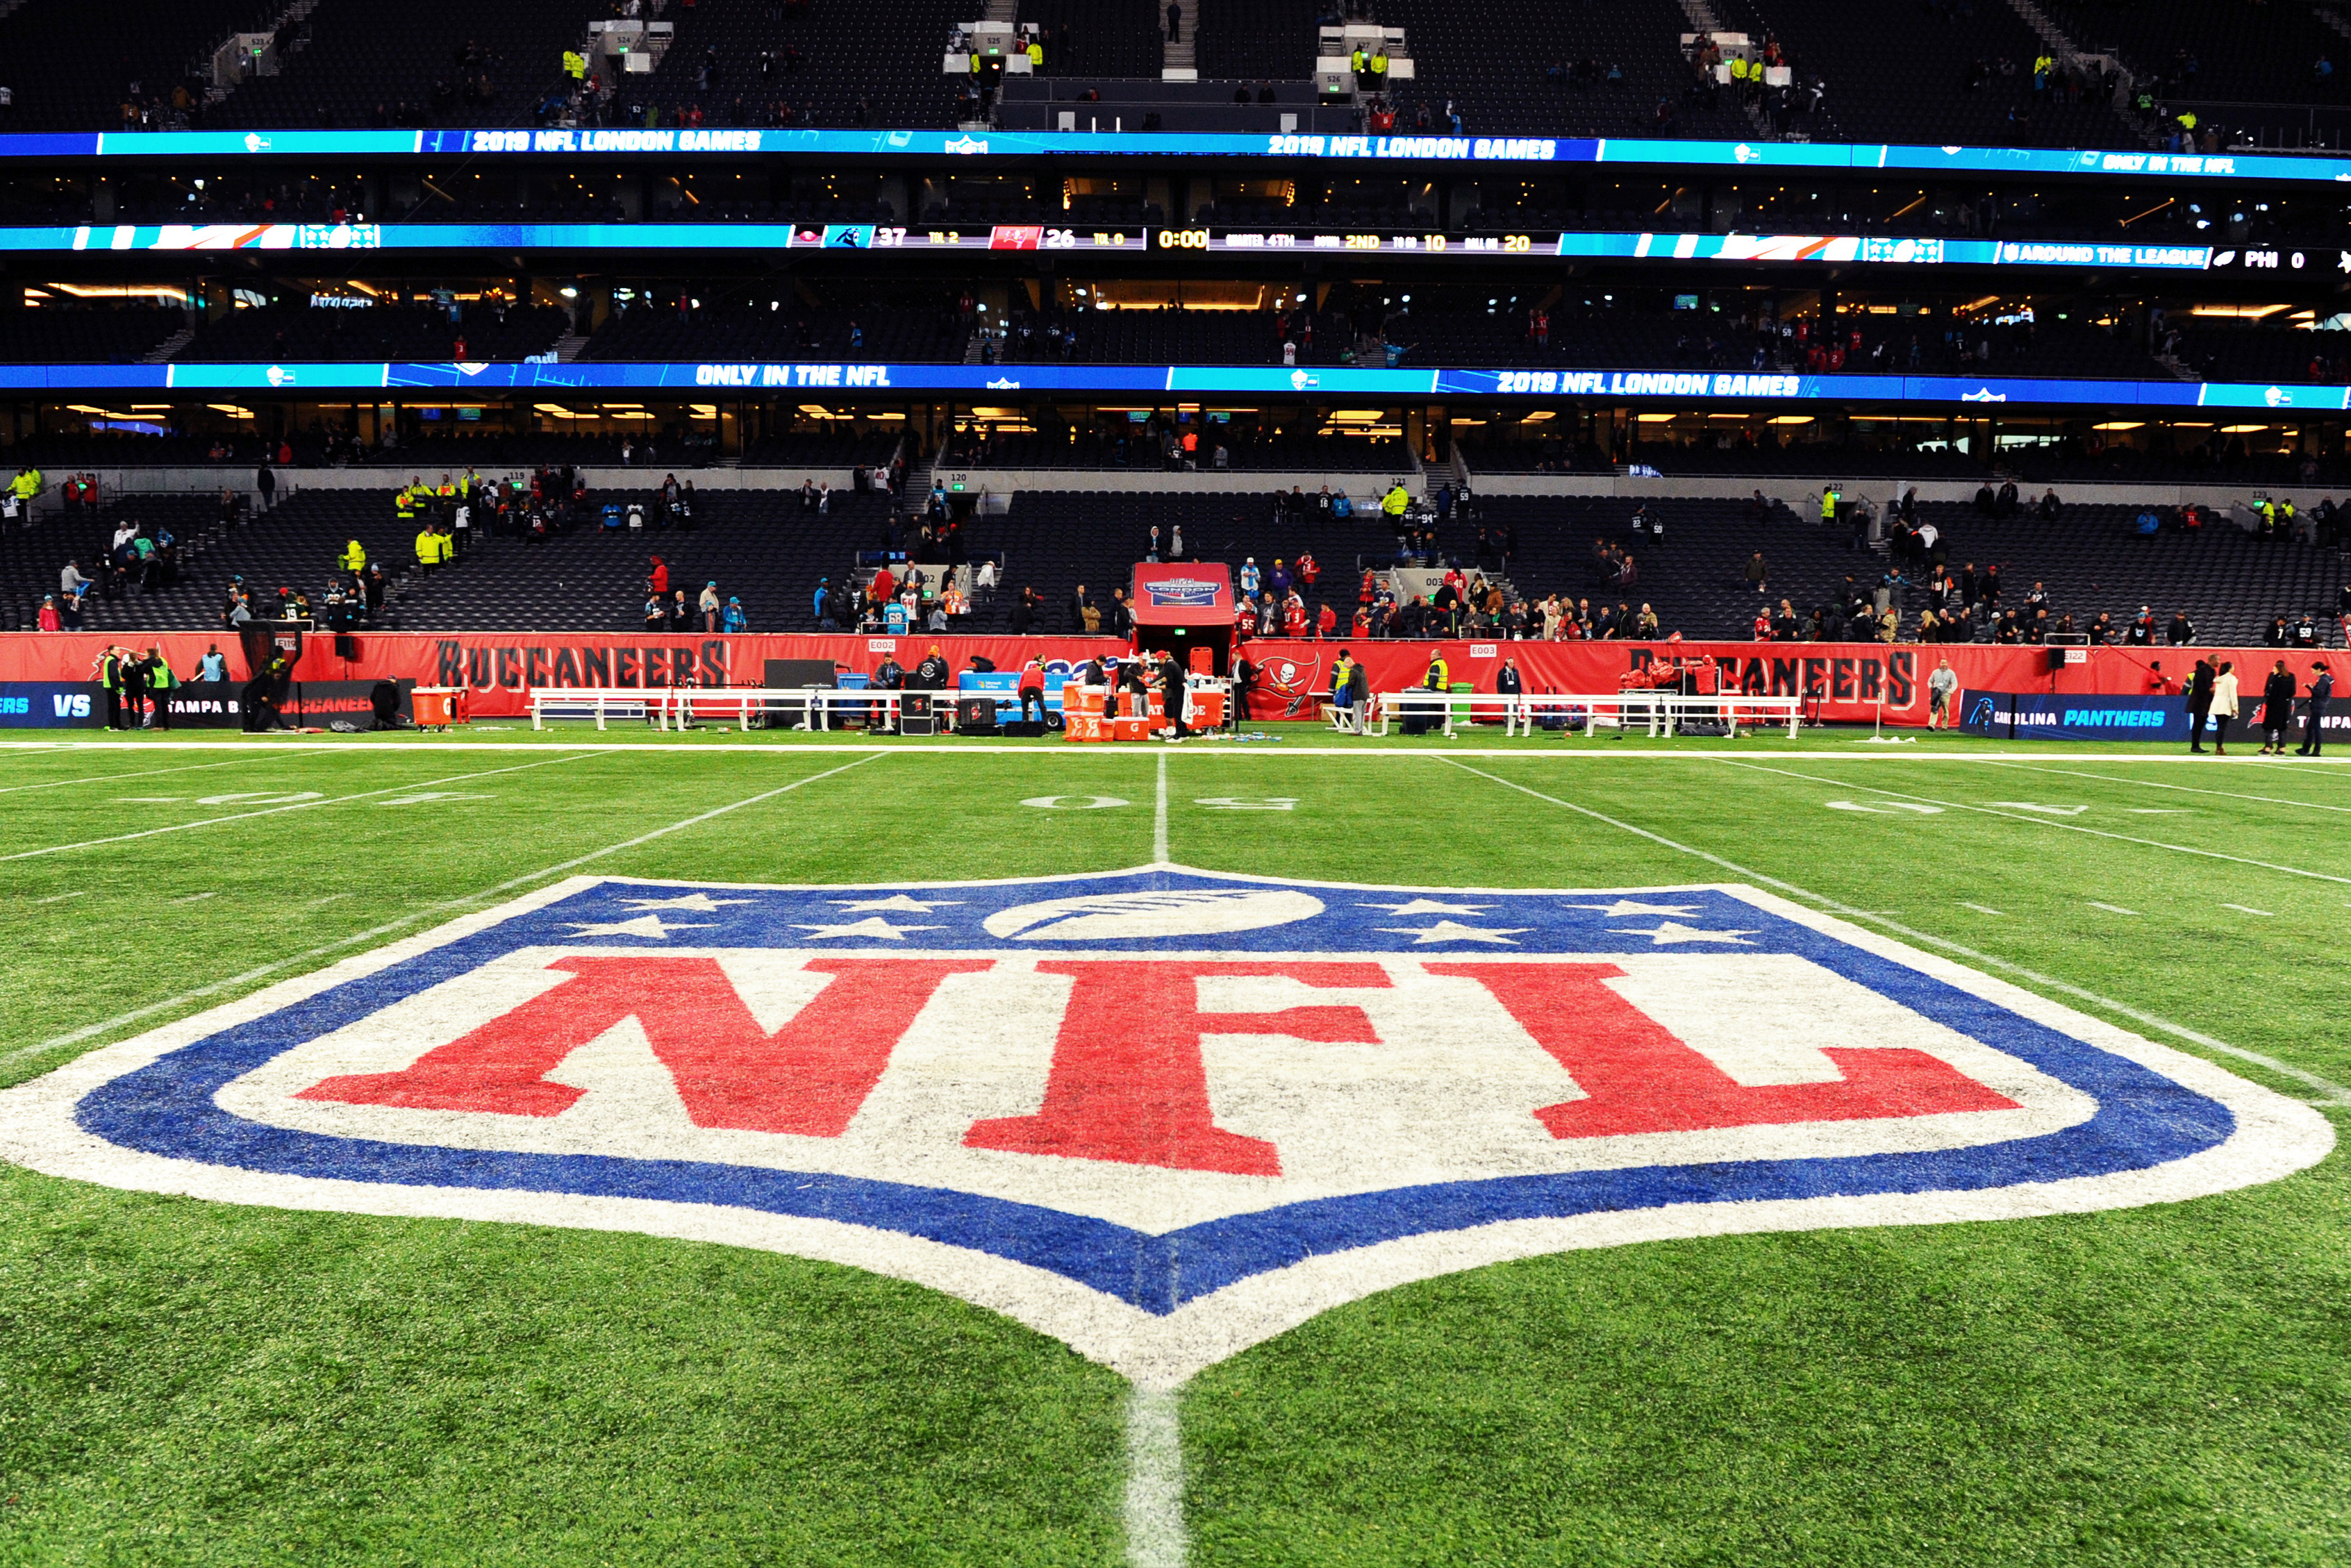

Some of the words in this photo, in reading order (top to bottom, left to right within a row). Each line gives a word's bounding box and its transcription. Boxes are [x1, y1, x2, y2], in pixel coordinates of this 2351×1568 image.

[473, 131, 530, 151] 2019
[535, 131, 576, 151] NFL
[581, 131, 674, 151] LONDON
[679, 131, 761, 151] GAMES
[1268, 135, 1324, 156] 2019
[1330, 137, 1371, 156] NFL
[1377, 137, 1470, 158] LONDON
[1474, 139, 1556, 160] GAMES
[2103, 154, 2146, 170] ONLY
[2148, 156, 2168, 172] IN
[2171, 157, 2202, 172] THE
[2204, 158, 2235, 174] NFL
[878, 228, 907, 246] 37
[949, 232, 958, 243] 2
[1046, 229, 1076, 248] 26
[1113, 233, 1124, 245] 0
[1158, 231, 1207, 248] 0:00
[1267, 234, 1295, 247] 4TH
[1345, 235, 1380, 249] 2ND
[1424, 235, 1446, 251] 10
[1503, 235, 1531, 251] 20
[2020, 244, 2093, 262] AROUND
[2096, 247, 2131, 264] THE
[2135, 249, 2205, 266] LEAGUE
[2245, 251, 2278, 268] PHI
[2291, 252, 2304, 268] 0
[1782, 328, 1792, 337] 59
[696, 365, 758, 385] ONLY
[763, 365, 790, 385] IN
[795, 365, 841, 385] THE
[845, 365, 890, 386] NFL
[1497, 372, 1557, 392] 2019
[1562, 373, 1606, 394] NFL
[1611, 374, 1710, 394] LONDON
[1714, 375, 1800, 397] GAMES
[876, 472, 884, 481] 40
[1320, 499, 1328, 508] 16
[1460, 493, 1469, 501] 59
[1422, 514, 1433, 523] 94
[1633, 519, 1641, 528] 22
[1654, 525, 1663, 533] 59
[1426, 578, 1443, 586] 003
[1934, 581, 1943, 591] 18
[902, 599, 914, 610] 54
[287, 608, 297, 619] 19
[888, 613, 904, 623] 68
[1242, 619, 1254, 630] 55
[2299, 628, 2311, 638] 59
[437, 640, 731, 692] BUCCANEERS
[1629, 648, 1917, 710] BCANEERS
[53, 694, 91, 717] VS
[443, 697, 451, 715] G
[1088, 719, 1097, 728] G
[2065, 710, 2166, 726] PANTHERS
[1130, 723, 1138, 732] G
[295, 957, 2025, 1177] NFL
